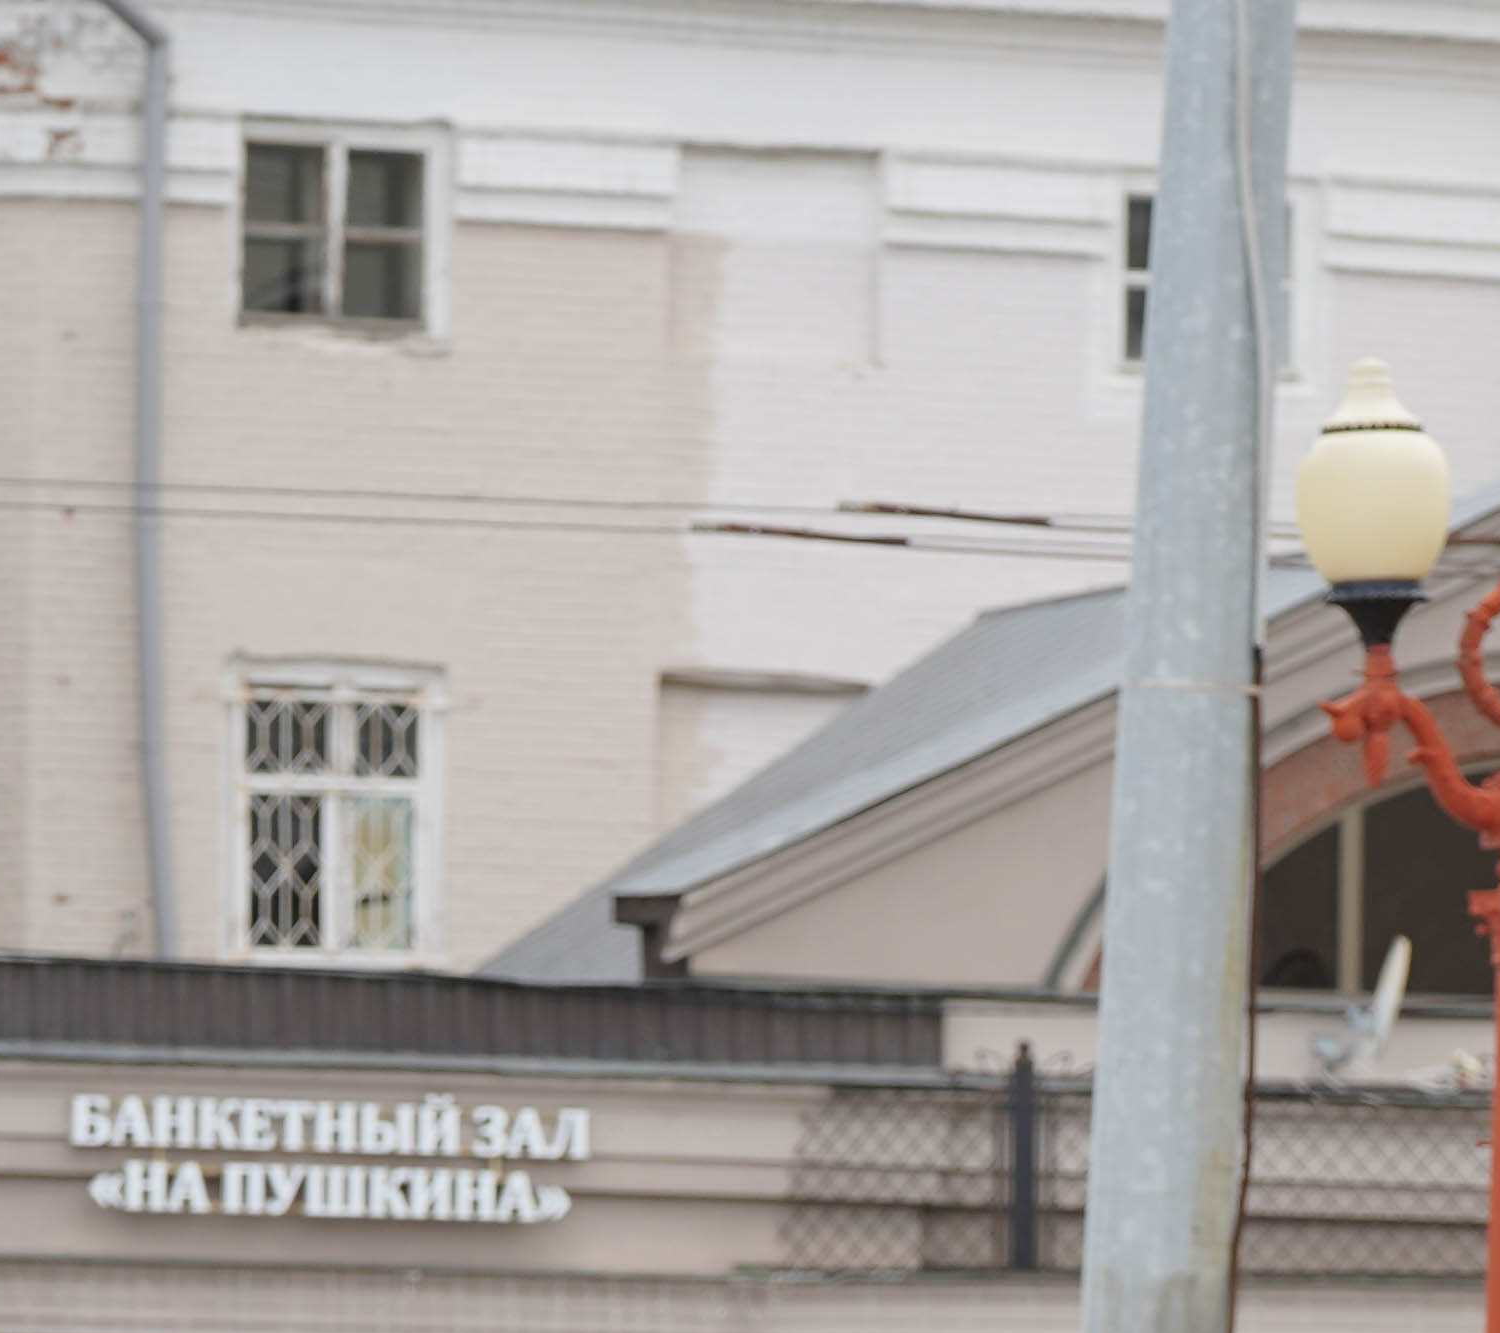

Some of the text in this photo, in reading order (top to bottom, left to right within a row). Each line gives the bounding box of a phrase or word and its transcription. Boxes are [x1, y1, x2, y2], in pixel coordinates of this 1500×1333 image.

[70, 1092, 591, 1160] БАНКЕТНЫЙ ЗАЛ
[88, 1159, 572, 1224] «НА ПУШКИНА»
